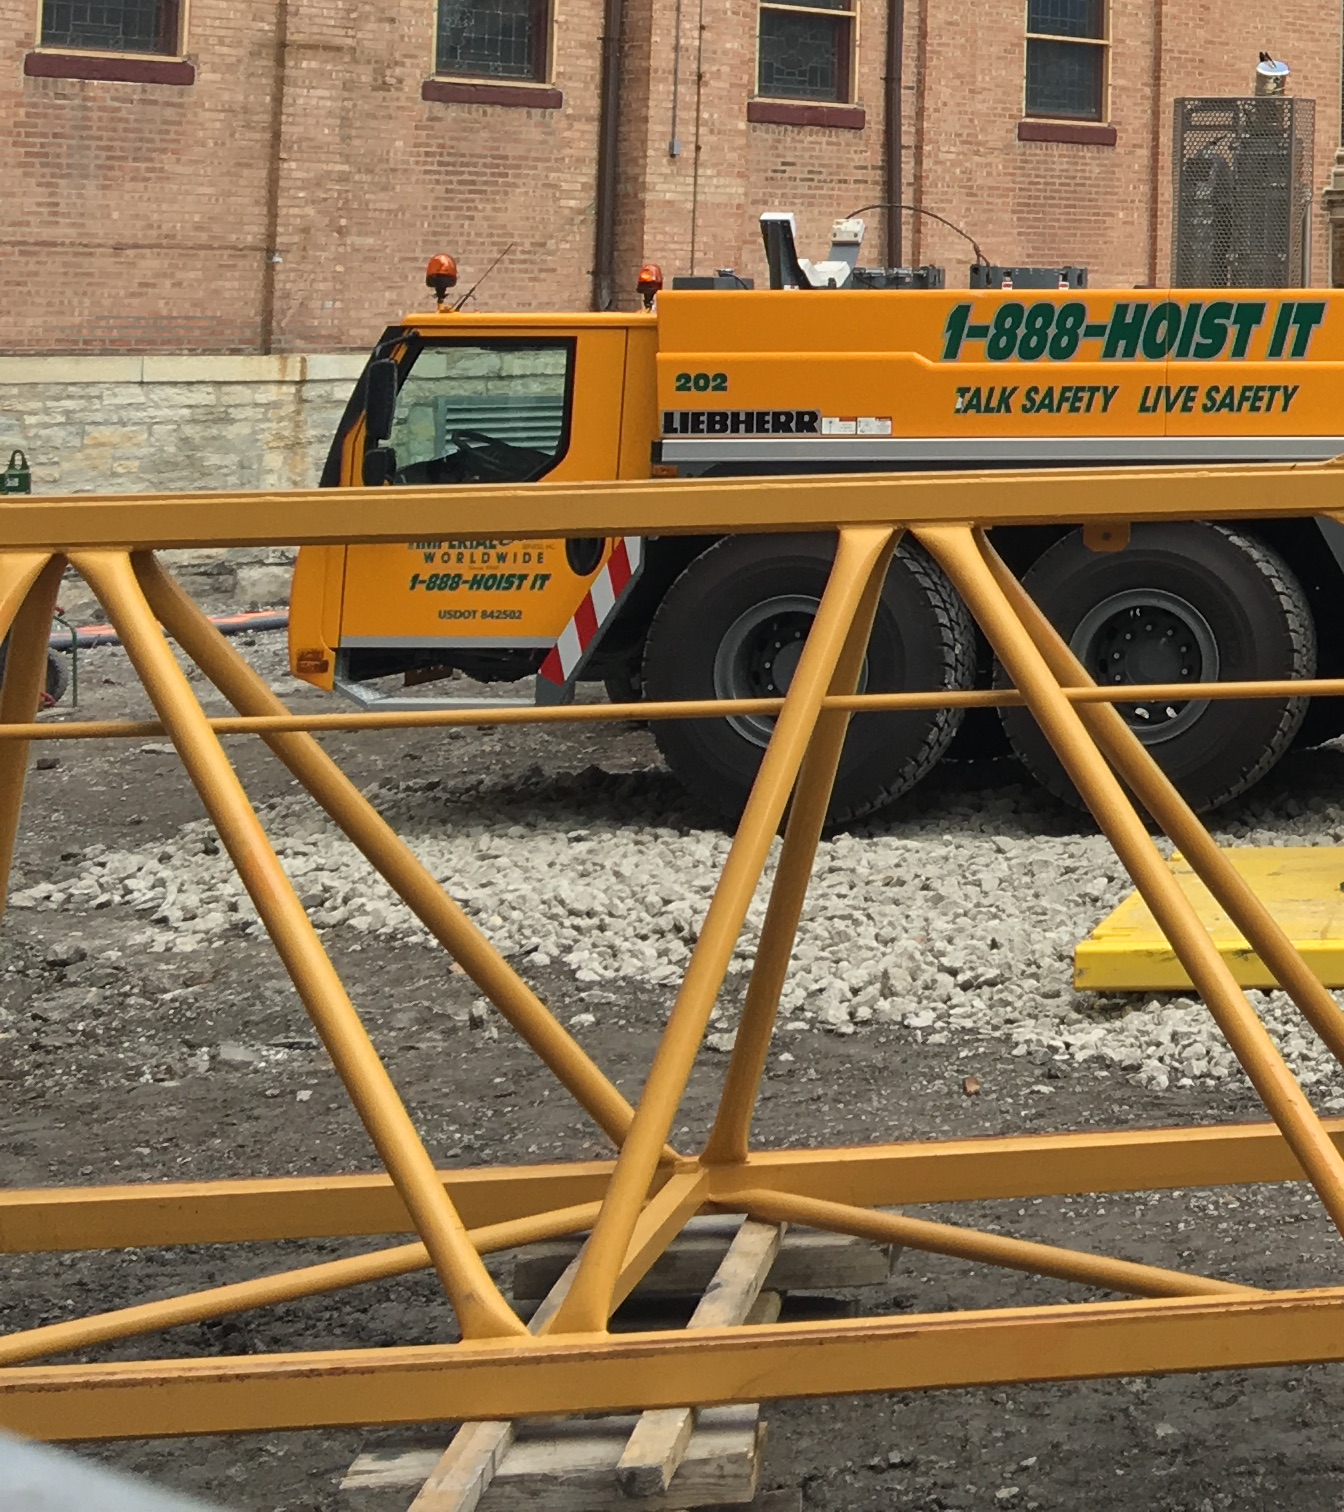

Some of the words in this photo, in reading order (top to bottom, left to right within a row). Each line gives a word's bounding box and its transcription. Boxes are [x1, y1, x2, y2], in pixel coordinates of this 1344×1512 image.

[941, 300, 1268, 361] 1-888-HOIST
[1266, 301, 1328, 360] IT
[675, 372, 729, 393] 202
[954, 384, 1019, 414] TALK
[1021, 384, 1120, 414] SAFETY
[1137, 384, 1199, 414] LIVE
[1201, 383, 1301, 414] SAFETY
[662, 410, 819, 435] LIEBHERR
[423, 551, 545, 564] WORLDWIDE
[408, 573, 530, 592] 1-888-HOIST
[529, 573, 552, 592] IT
[438, 609, 479, 620] USDOT
